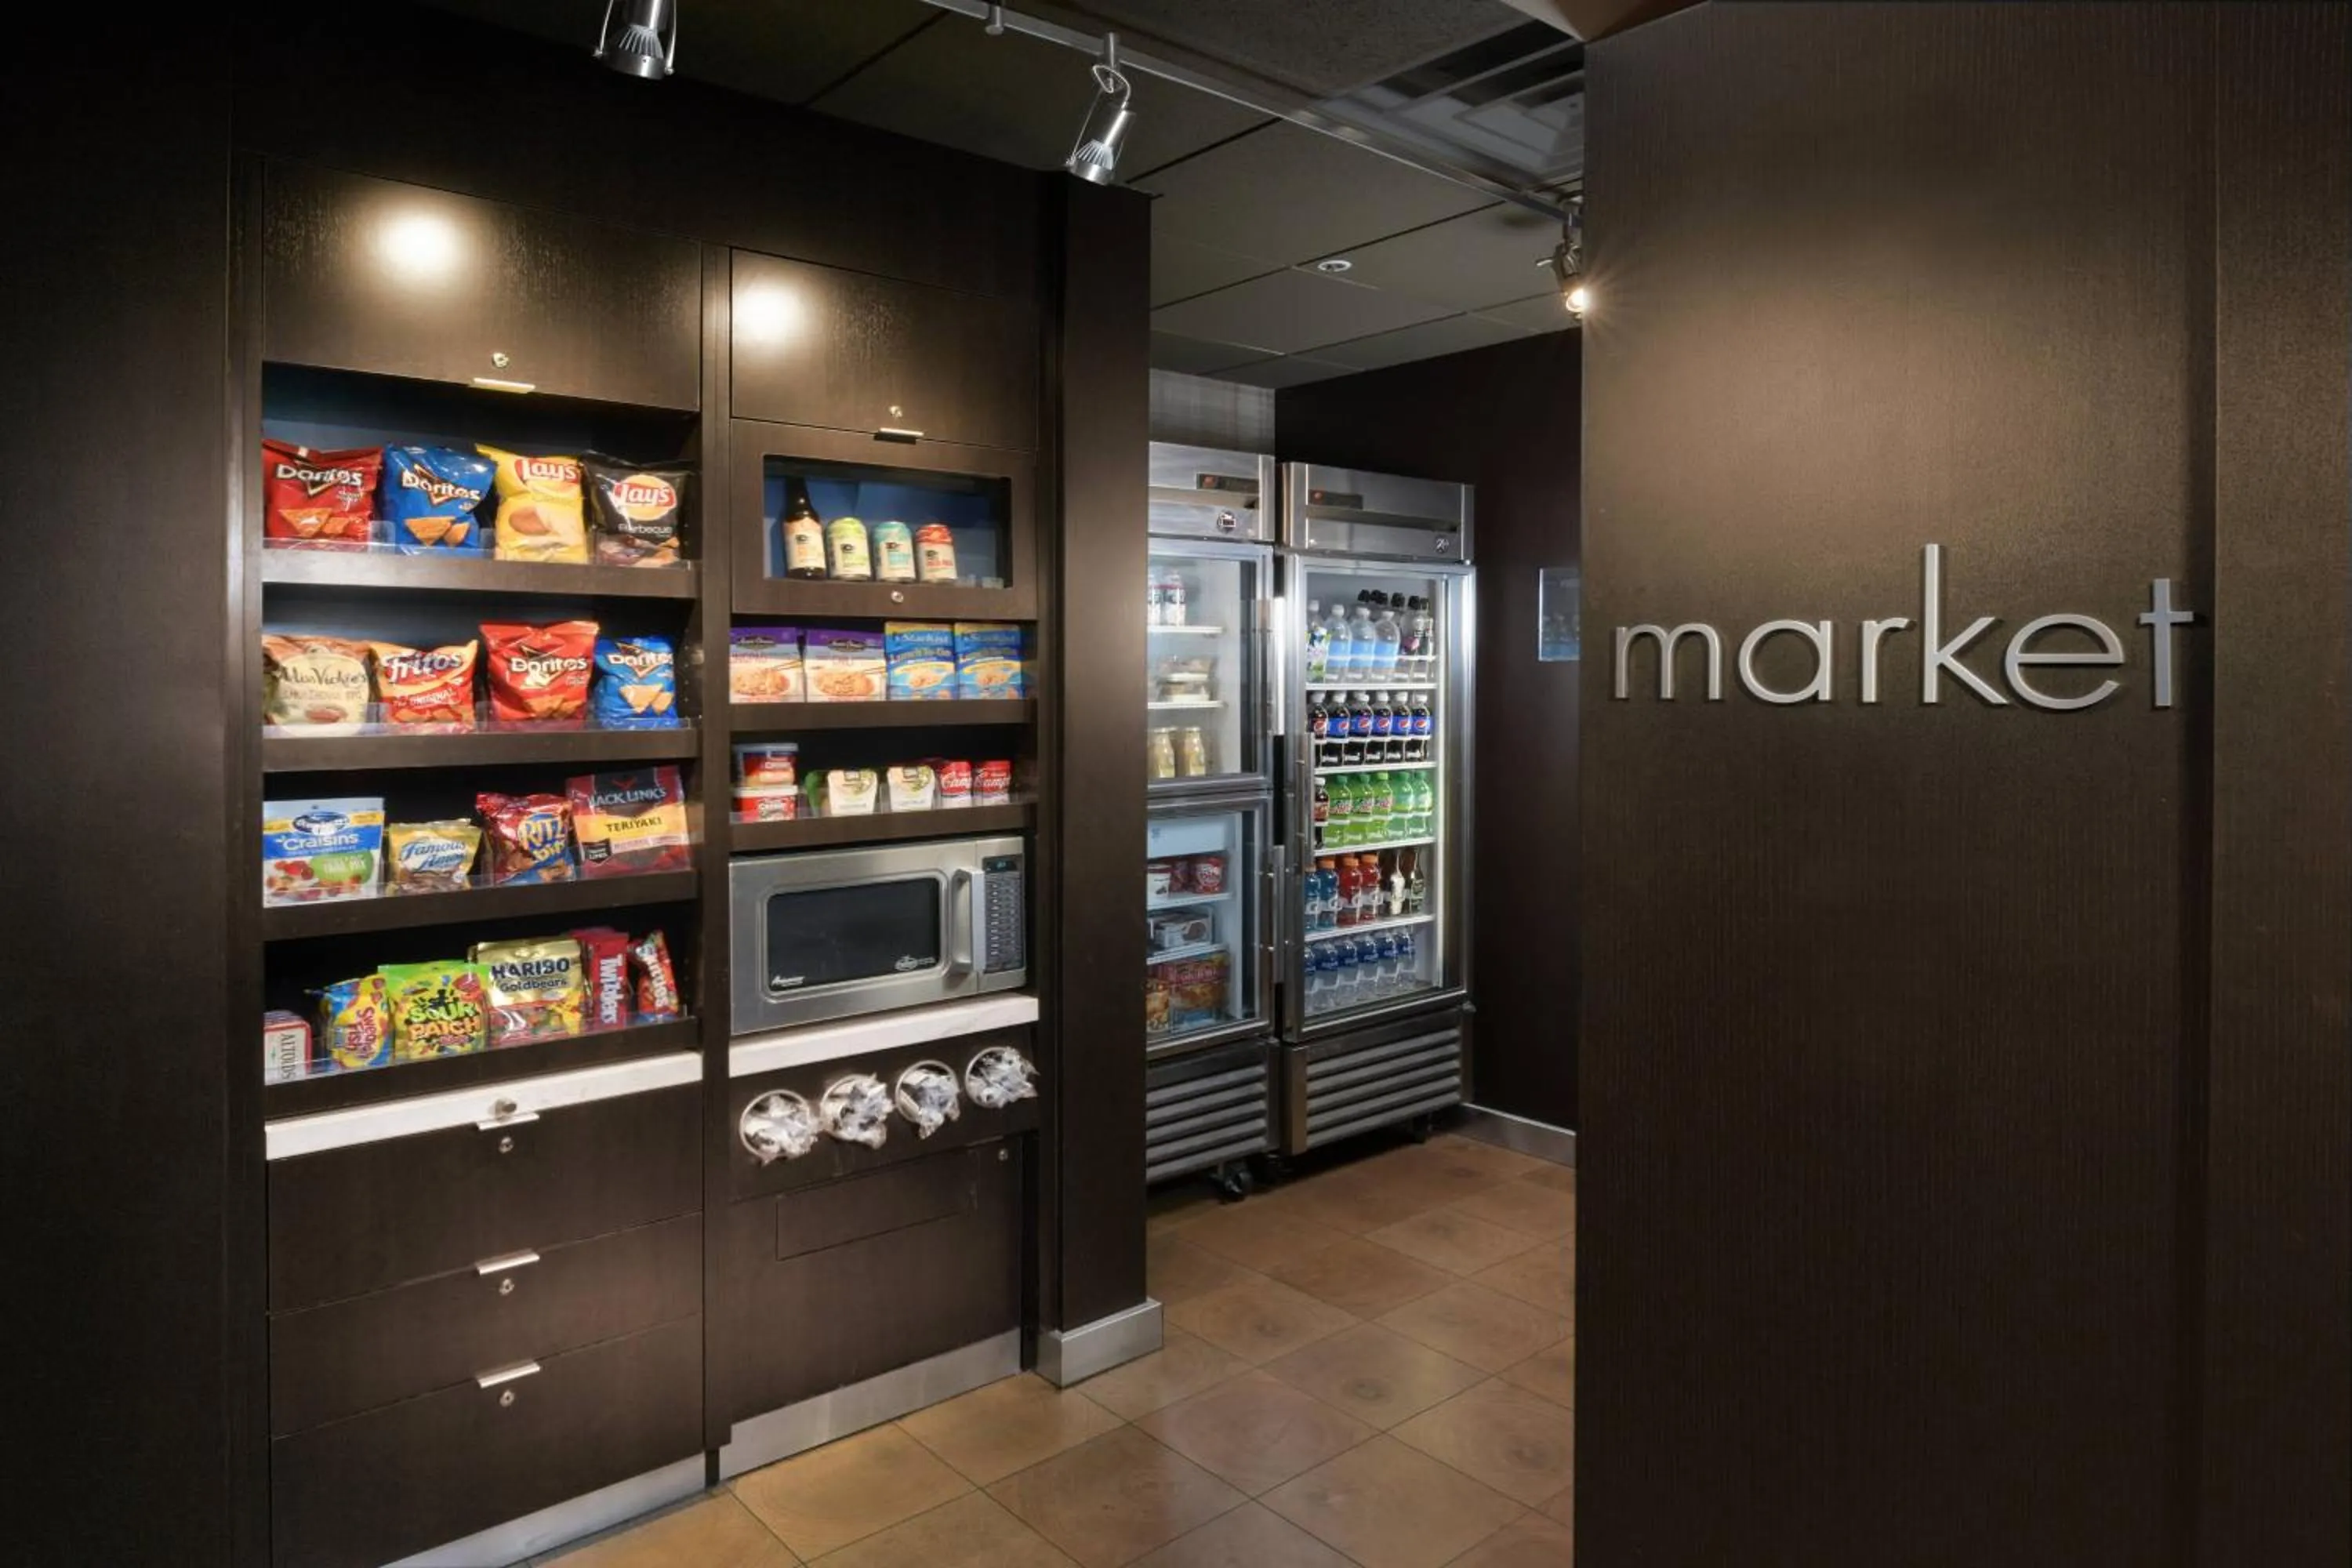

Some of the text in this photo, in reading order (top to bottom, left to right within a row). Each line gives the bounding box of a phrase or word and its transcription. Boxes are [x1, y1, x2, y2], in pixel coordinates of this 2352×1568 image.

[277, 463, 363, 486] Doritos
[522, 458, 579, 482] Lay's
[402, 470, 481, 500] Doritos
[619, 483, 671, 507] Lay's
[1615, 543, 2194, 710] market
[382, 651, 463, 682] Fritos
[510, 655, 587, 673] Doritos
[605, 817, 662, 832] TERIYAKI
[283, 833, 359, 851] Craisins
[492, 957, 569, 979] HARIBO
[499, 978, 568, 993] Goldbears
